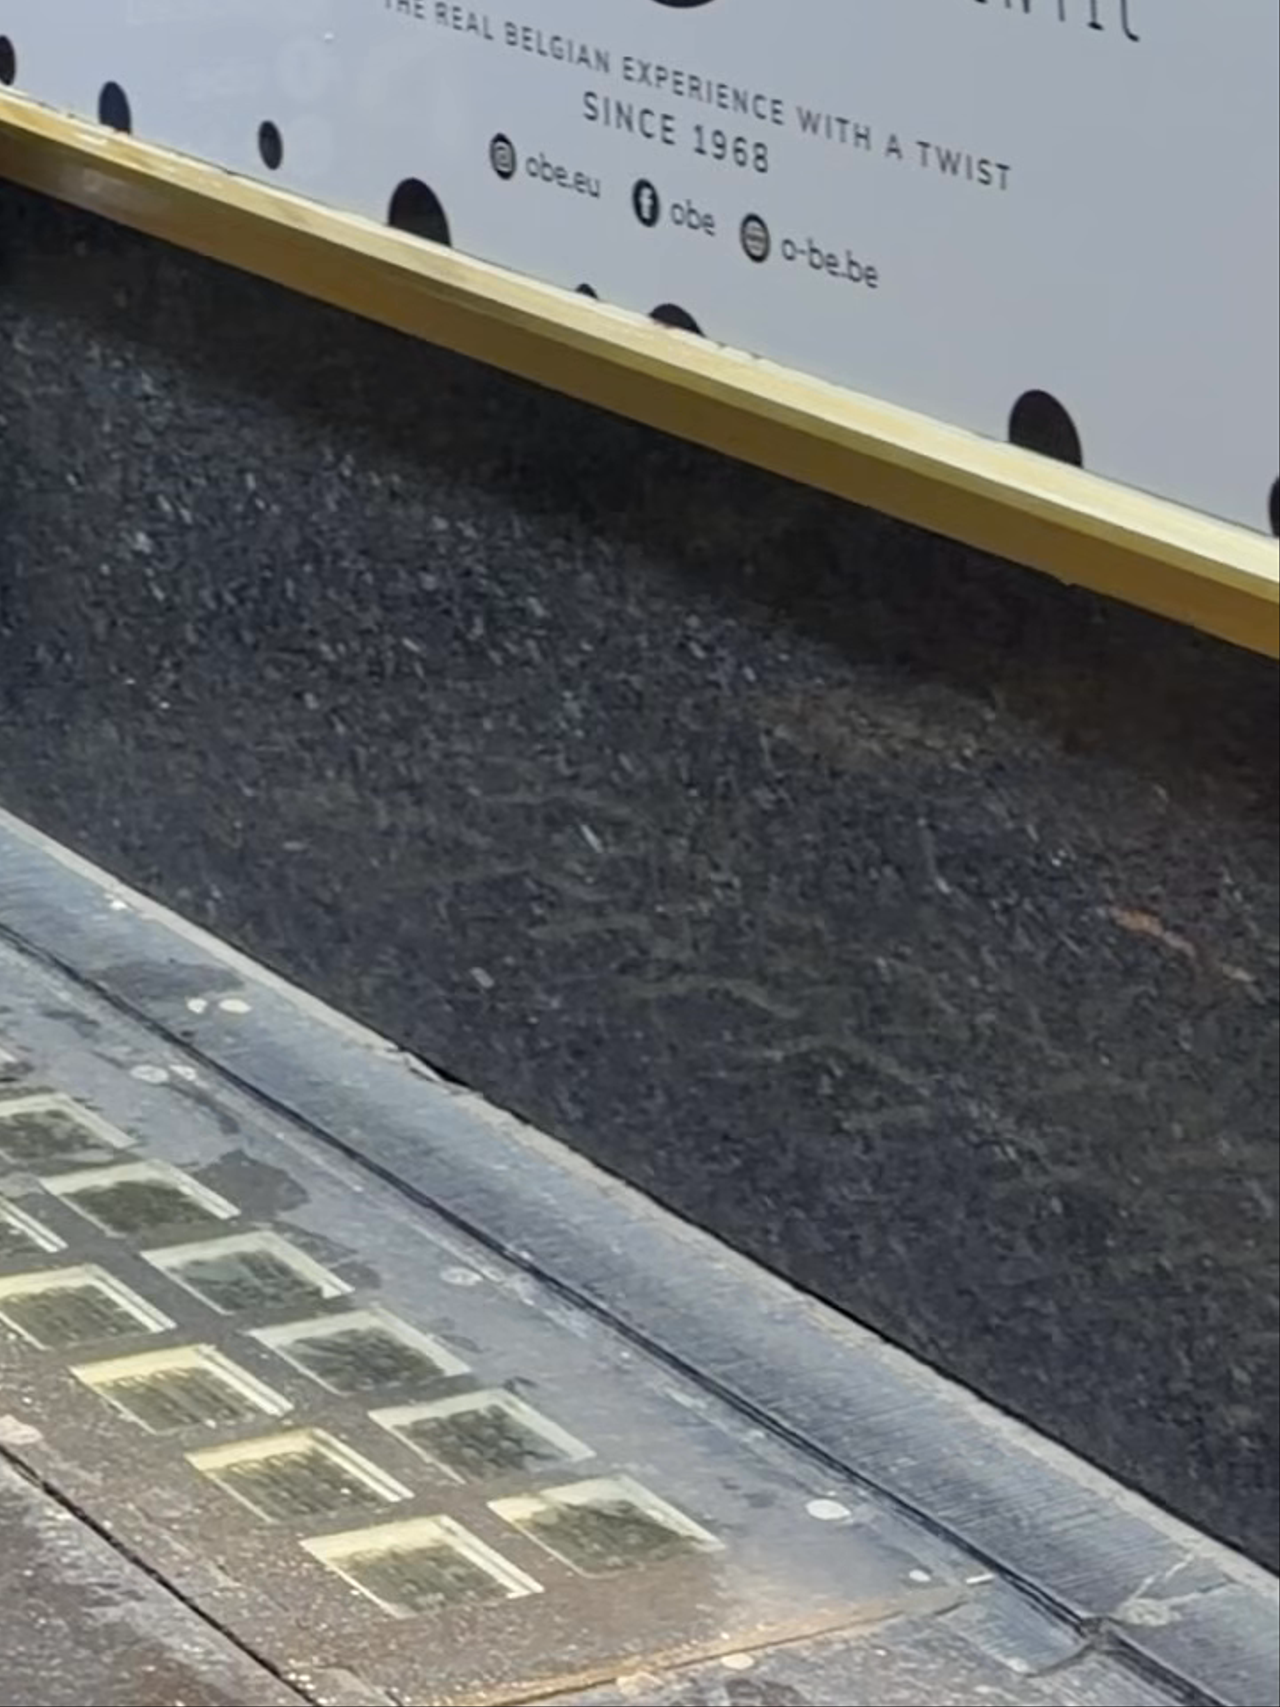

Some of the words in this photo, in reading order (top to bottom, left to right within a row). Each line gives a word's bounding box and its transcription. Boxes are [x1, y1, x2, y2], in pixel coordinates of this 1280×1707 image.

[435, 1, 495, 41] REAL
[504, 22, 611, 74] BELGIAN
[622, 56, 785, 126] EXPERIENCE
[796, 106, 872, 151] WITH
[886, 133, 903, 161] A
[916, 140, 1011, 191] TWIST
[583, 91, 675, 146] SINCE
[693, 124, 769, 174] 1968
[525, 152, 601, 199] obe.eu
[670, 199, 716, 236] obe
[781, 238, 879, 289] o-be.be
